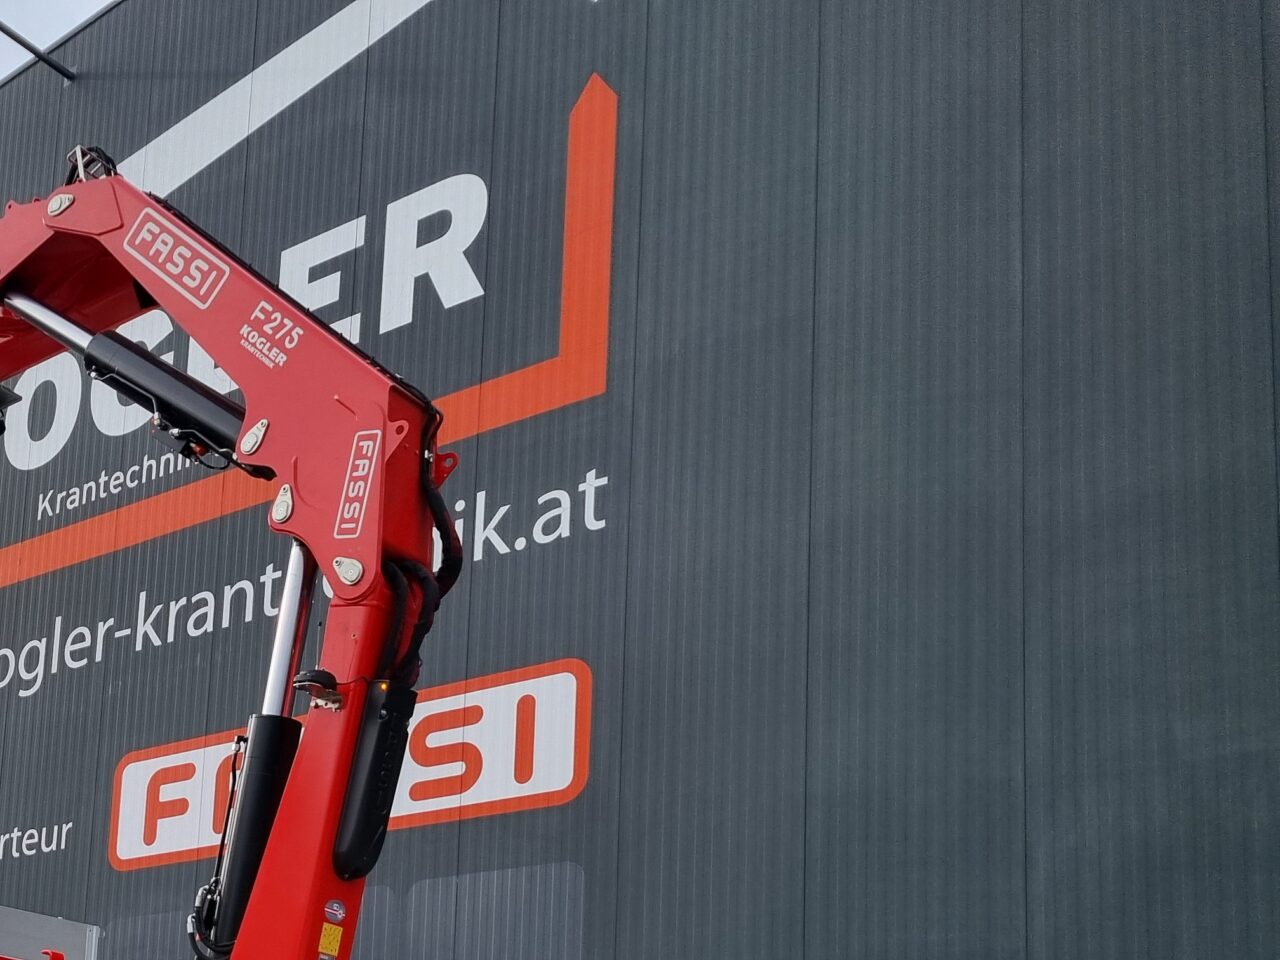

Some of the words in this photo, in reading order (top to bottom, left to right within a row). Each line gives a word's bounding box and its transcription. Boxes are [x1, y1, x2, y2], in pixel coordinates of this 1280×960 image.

[135, 221, 217, 296] FASSI
[240, 323, 287, 367] KOGLER
[250, 300, 304, 349] F275
[37, 452, 201, 520] Krantechni
[340, 440, 374, 529] FASSI
[142, 693, 537, 847] FSI
